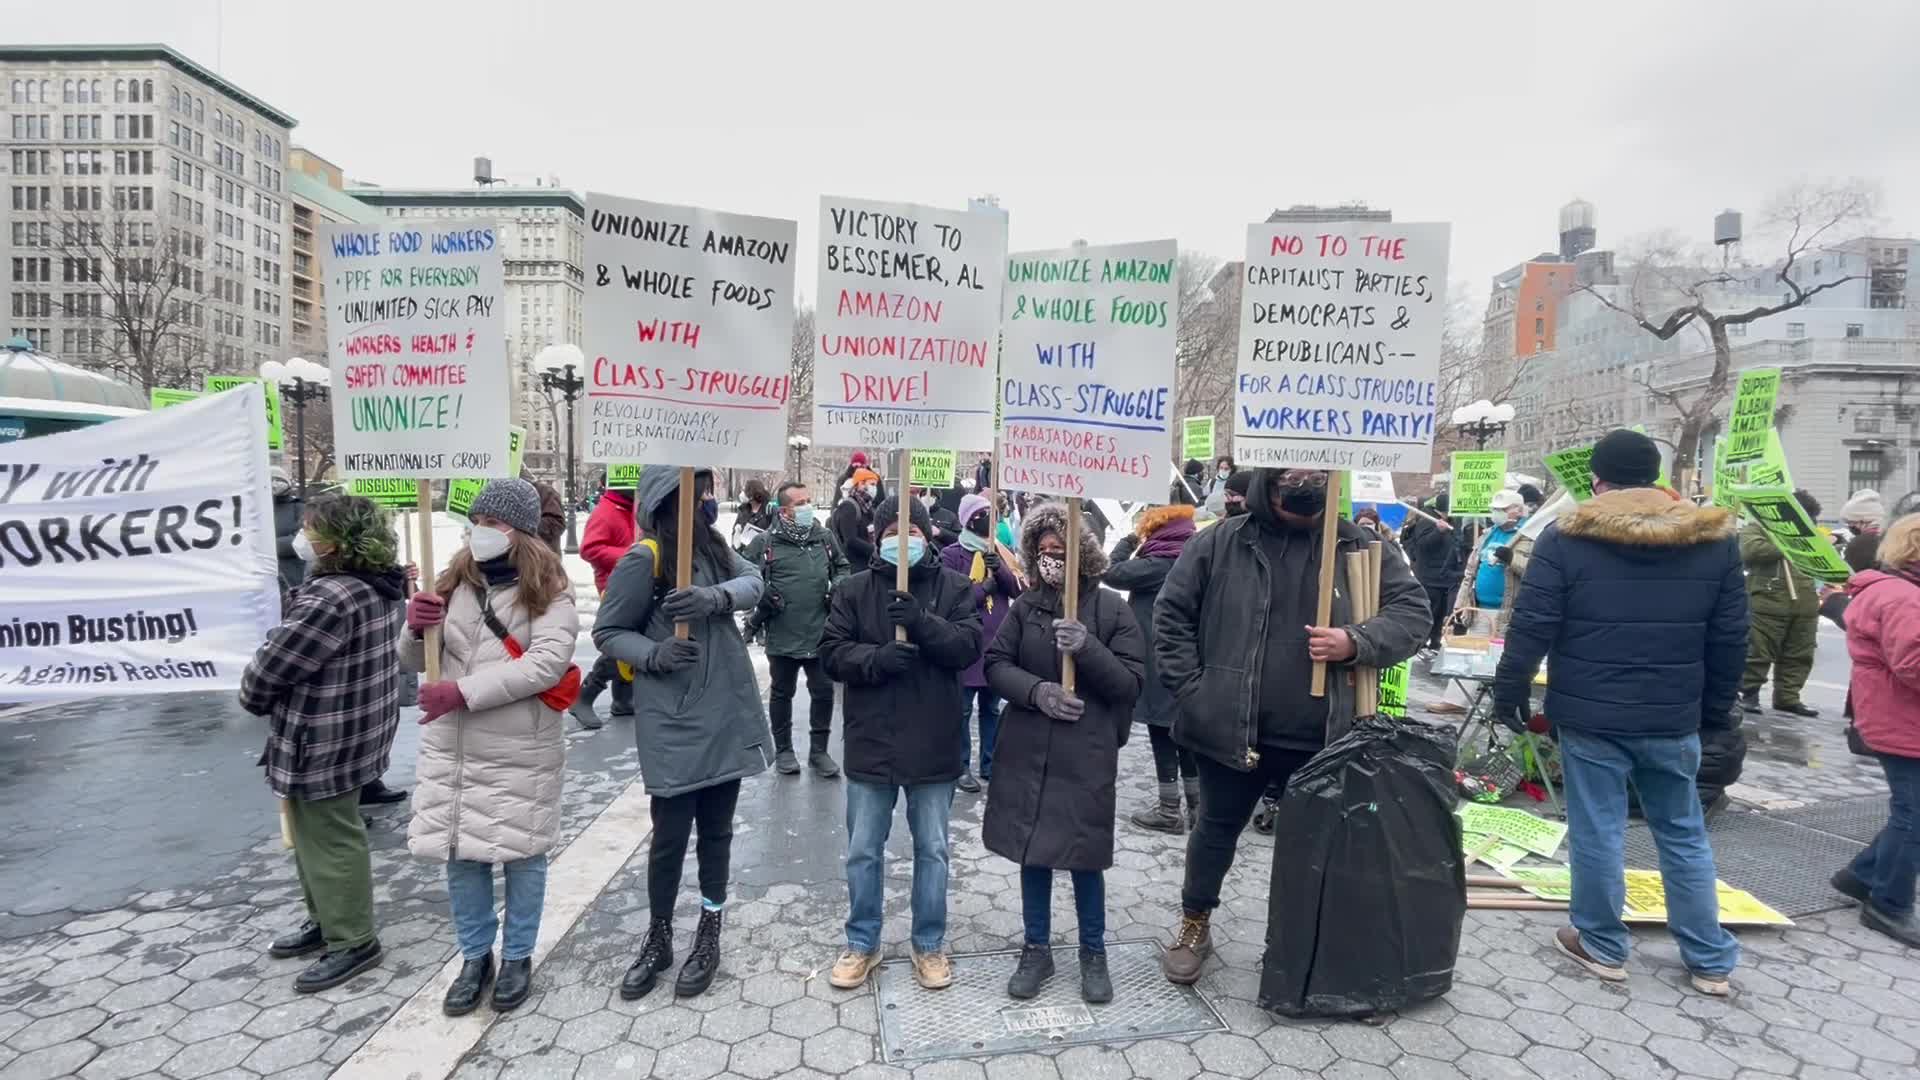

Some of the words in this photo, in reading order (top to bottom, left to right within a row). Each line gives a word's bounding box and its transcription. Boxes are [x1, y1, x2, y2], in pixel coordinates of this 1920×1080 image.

[331, 232, 380, 258] WHOLE
[389, 232, 422, 253] FOOD
[432, 229, 494, 254] WORKERS
[591, 209, 690, 248] UNIONIZE
[702, 230, 789, 264] AMAZON
[831, 208, 918, 245] VICTORY
[933, 224, 961, 252] TO
[1271, 235, 1303, 256] NO
[1316, 233, 1347, 257] TO
[1360, 236, 1407, 262] THE
[381, 268, 402, 287] FOR
[410, 266, 480, 287] EVERYBODY
[827, 244, 949, 287] BESSEMER,
[957, 264, 984, 290] AL
[1008, 259, 1092, 283] UNIONIZE
[1100, 258, 1174, 283] AMAZON
[596, 264, 611, 287] &
[621, 265, 696, 299] WHOLE
[712, 280, 776, 311] FOODS
[1248, 265, 1344, 290] CAPITALIST
[1355, 268, 1432, 303] PARTIES,
[344, 296, 417, 324] UNLIMITED
[424, 297, 460, 320] SICK
[466, 295, 494, 318] PAY
[838, 289, 942, 323] AMAZON
[1012, 295, 1026, 320] &
[1032, 297, 1096, 324] WHOLE
[1110, 296, 1168, 328] FOODS
[1253, 301, 1375, 330] DEMOCRATS
[1390, 306, 1410, 330] &
[345, 334, 401, 356] WORKERS
[412, 333, 456, 354] HEALTH
[637, 318, 700, 349] WITH
[822, 334, 987, 368] UNIONIZATION
[1036, 341, 1096, 370] WITH
[344, 364, 385, 389] SAFETY
[594, 357, 789, 404] CLASS-STRUGGLE!
[840, 371, 928, 405] DRIVE!
[1240, 374, 1272, 394] FOR
[1278, 374, 1291, 394] A
[1296, 373, 1346, 398] CLASS
[1348, 377, 1435, 406] STRUGGLE
[352, 393, 463, 432] UNIONIZE!
[1005, 379, 1168, 421] CLASS-STRUGGLE
[594, 401, 719, 429] REVOLUTIONARY
[827, 409, 948, 429] INTERNATIONALIST
[1243, 405, 1352, 436] WORKERS
[1361, 407, 1434, 440] PARTY!
[592, 440, 647, 456] GROUP
[593, 419, 744, 448] INTERNATIONALIST
[861, 427, 903, 444] GROUP
[1004, 425, 1116, 453] TRABAJADORES
[345, 454, 445, 469] INTERNATIONALIST
[452, 452, 491, 469] GROUP
[912, 456, 950, 468] AMAZON
[1004, 443, 1151, 478] INTERNACIONALES
[1240, 448, 1353, 465] INTERNATIONALIST
[1363, 450, 1400, 468] GROUP
[42, 454, 160, 500] with
[356, 478, 417, 492] DISGUSTING
[915, 470, 945, 480] UNION
[1004, 469, 1083, 494] CLASISTAS
[1462, 484, 1492, 492] STOLEN
[0, 496, 242, 568] ORKERS!
[0, 614, 60, 648] nion
[68, 608, 197, 644] Busting!
[8, 662, 117, 686] Against
[120, 658, 218, 681] Racism
